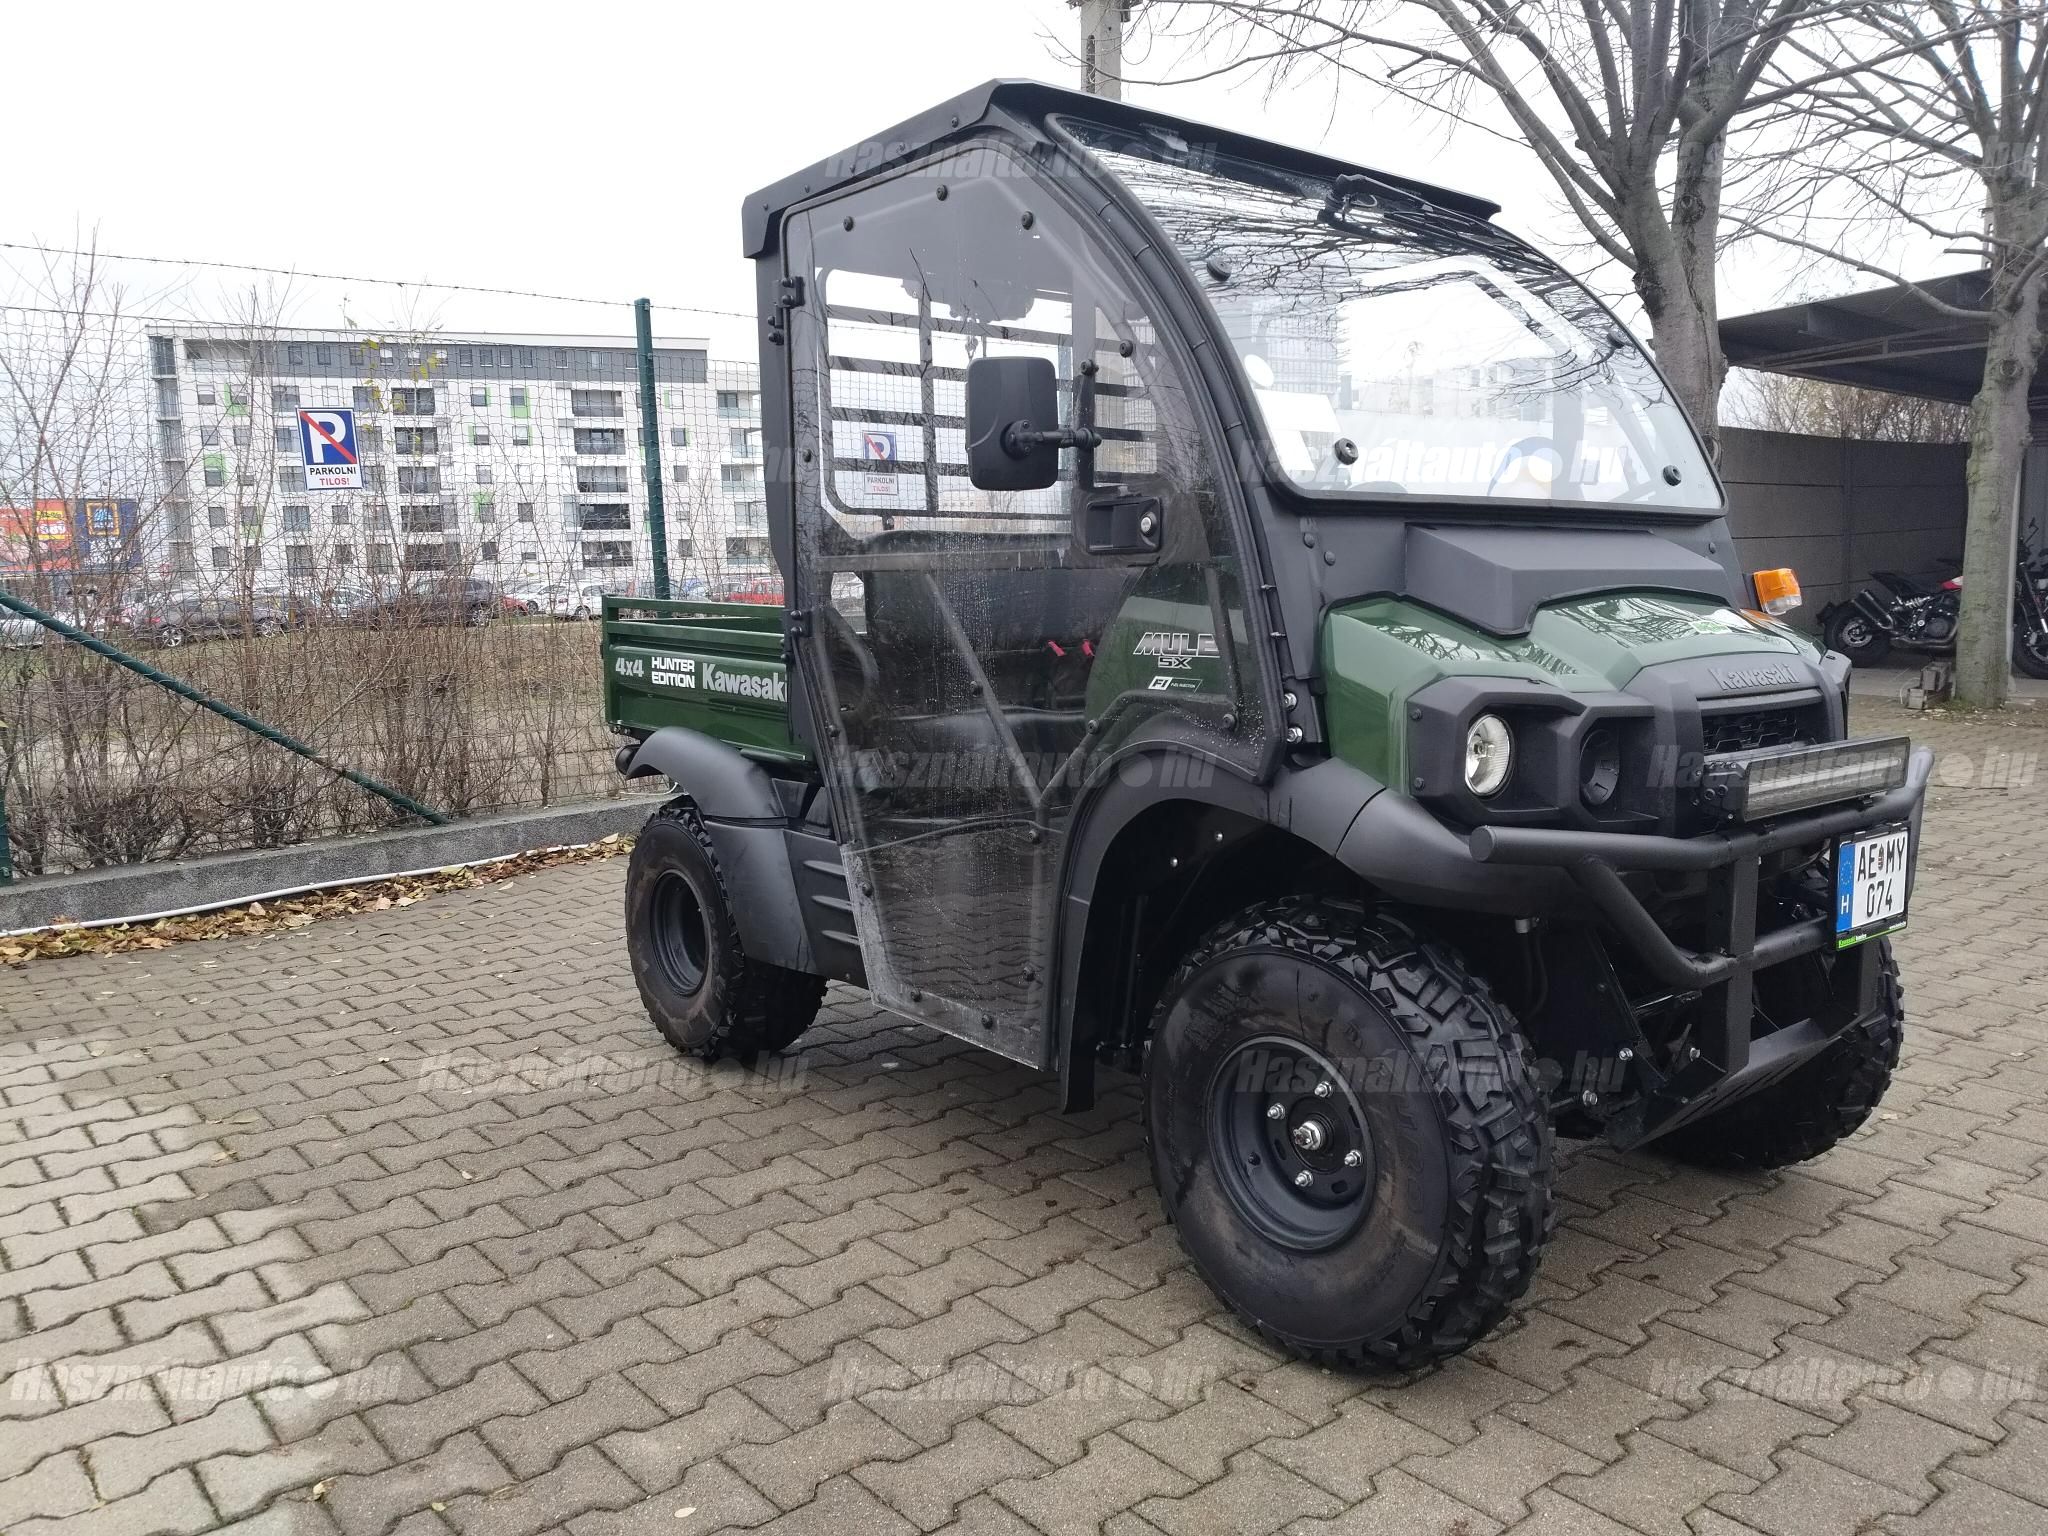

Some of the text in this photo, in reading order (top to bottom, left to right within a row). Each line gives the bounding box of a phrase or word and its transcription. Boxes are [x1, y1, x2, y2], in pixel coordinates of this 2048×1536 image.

[310, 467, 356, 475] PARKOLNI
[319, 478, 350, 486] TILOS!
[1133, 632, 1220, 658] MULE
[615, 657, 645, 678] 4x4
[651, 656, 696, 673] HUNTER
[1158, 656, 1193, 670] SX
[651, 671, 696, 689] EDITION
[1707, 664, 1801, 691] Kawasaki
[1857, 836, 1906, 882] AE MY
[1841, 894, 1850, 915] H
[1866, 878, 1893, 918] 074
